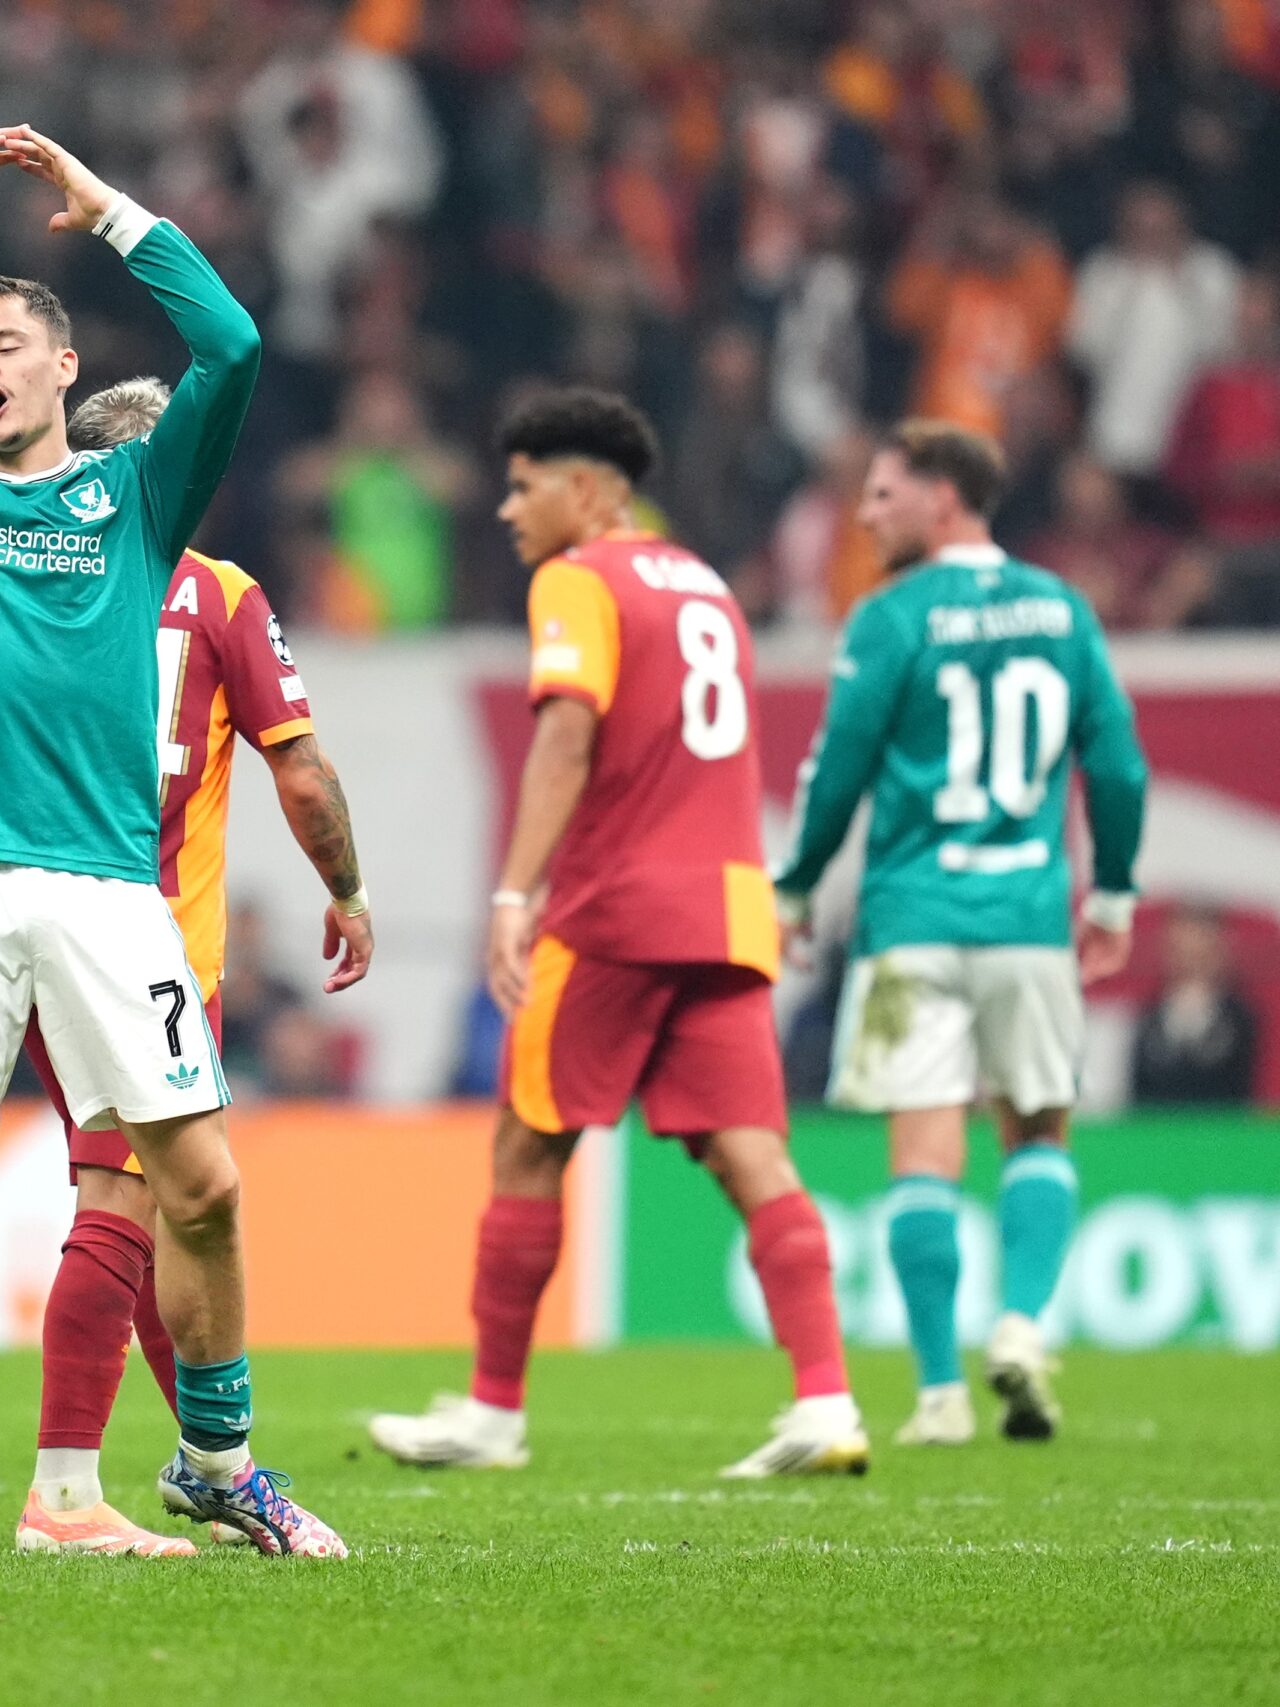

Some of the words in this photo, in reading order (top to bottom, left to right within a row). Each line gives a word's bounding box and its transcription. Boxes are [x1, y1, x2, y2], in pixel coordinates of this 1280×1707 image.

[676, 600, 748, 760] 8
[934, 655, 1071, 824] 10
[148, 979, 186, 1058] 7
